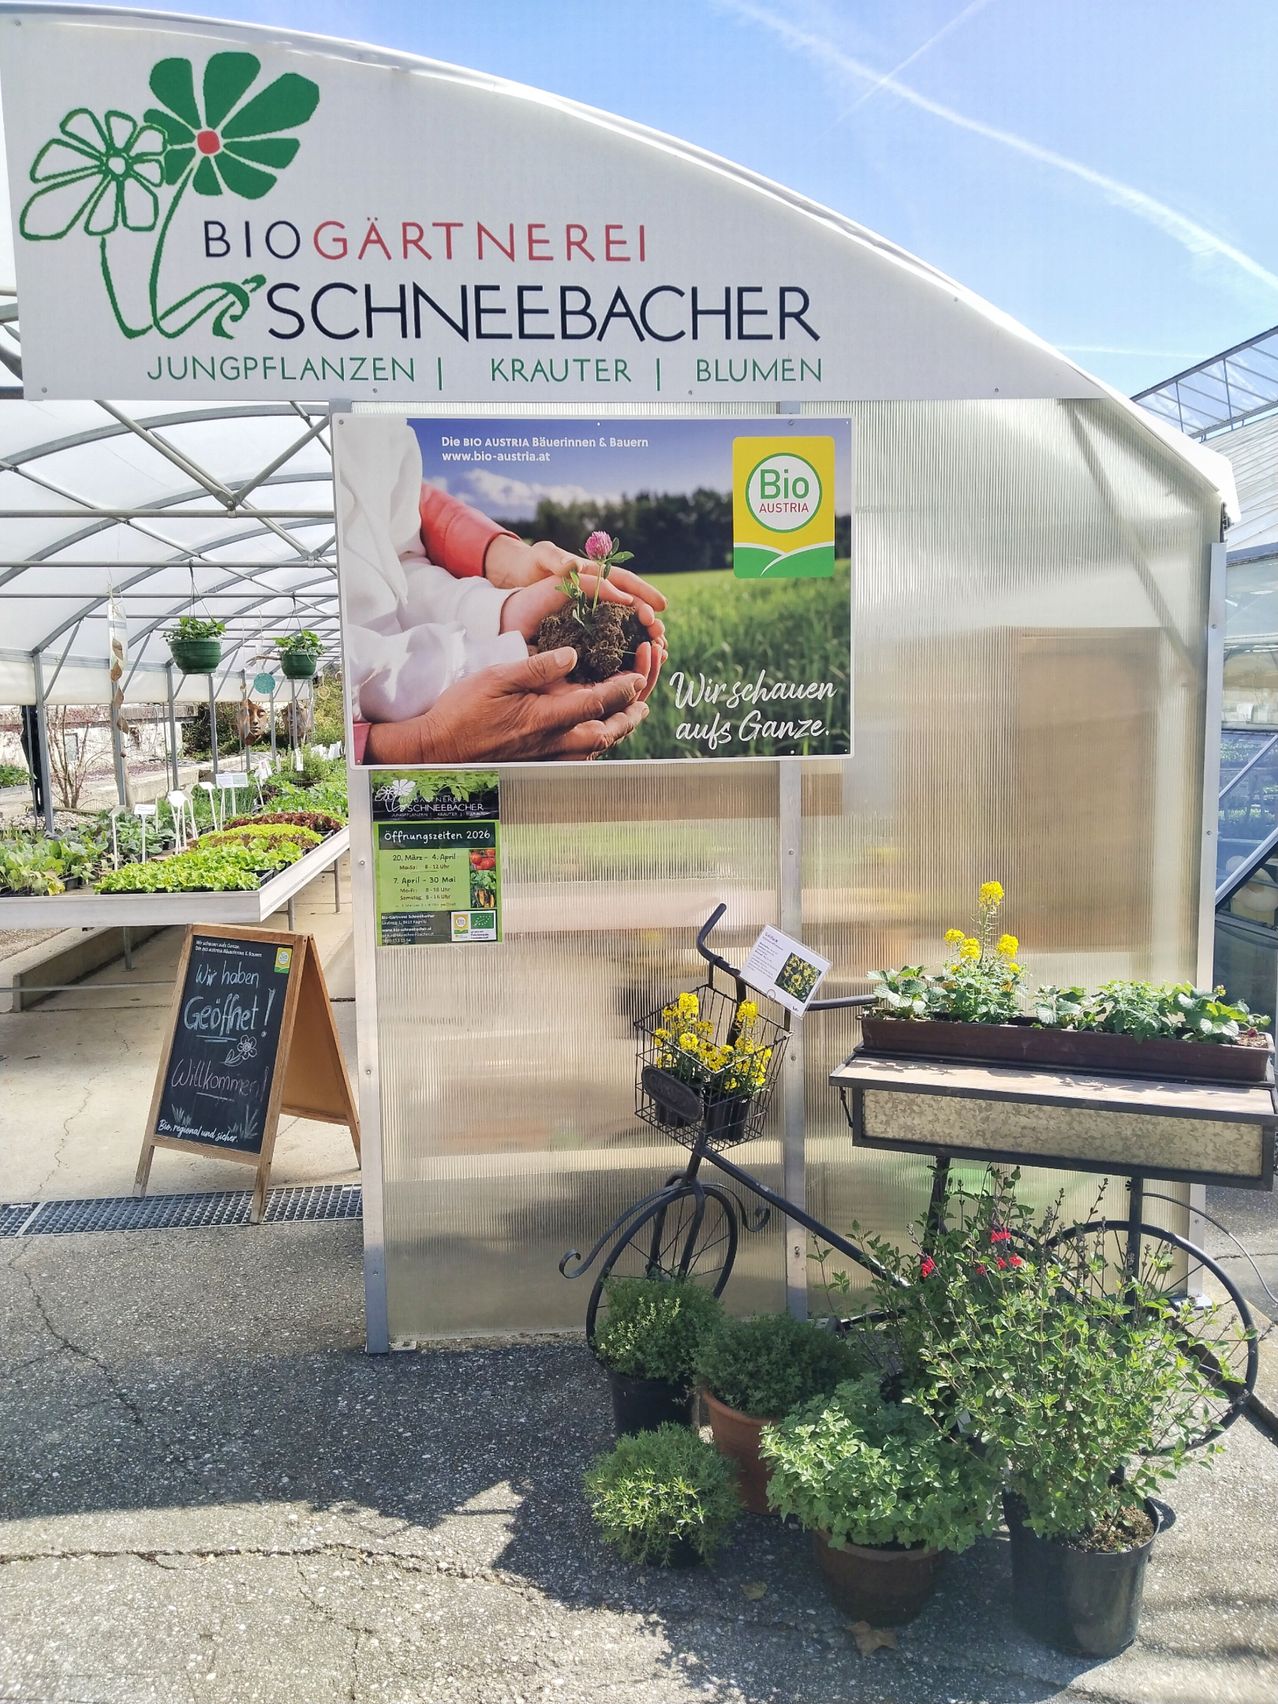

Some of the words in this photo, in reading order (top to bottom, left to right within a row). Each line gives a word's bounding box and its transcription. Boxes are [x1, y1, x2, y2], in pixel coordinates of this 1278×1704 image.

[204, 216, 646, 263] BIOGÄRTNEREI
[266, 281, 820, 343] SCHNEEBACHER
[147, 356, 415, 382] JUNGPFLANZEN
[696, 357, 822, 383] BLUMEN
[441, 436, 460, 447] Die
[463, 438, 482, 447] BIO
[485, 438, 530, 448] AUSTRIA
[532, 437, 596, 448] Bäuerinnen
[599, 438, 607, 448] &
[609, 437, 649, 448] Bauern
[442, 451, 551, 462] www.bio-austria.at
[760, 469, 810, 500] Bio
[759, 502, 809, 513] AUSTRIA
[669, 671, 727, 709] Wir
[726, 669, 838, 709] schauen
[675, 712, 732, 750] aufs
[738, 709, 830, 742] Ganze.
[407, 803, 485, 813] SCHNEEBACHER
[384, 830, 463, 844] Öffnungszeiten
[466, 829, 491, 840] 2026
[440, 853, 456, 863] April
[401, 876, 420, 887] April
[195, 963, 217, 987] Wir
[221, 959, 259, 989] haben
[158, 1118, 173, 1132] Bio,
[172, 1124, 202, 1138] regional
[200, 1127, 217, 1139] und
[215, 1130, 239, 1143] sicher.
